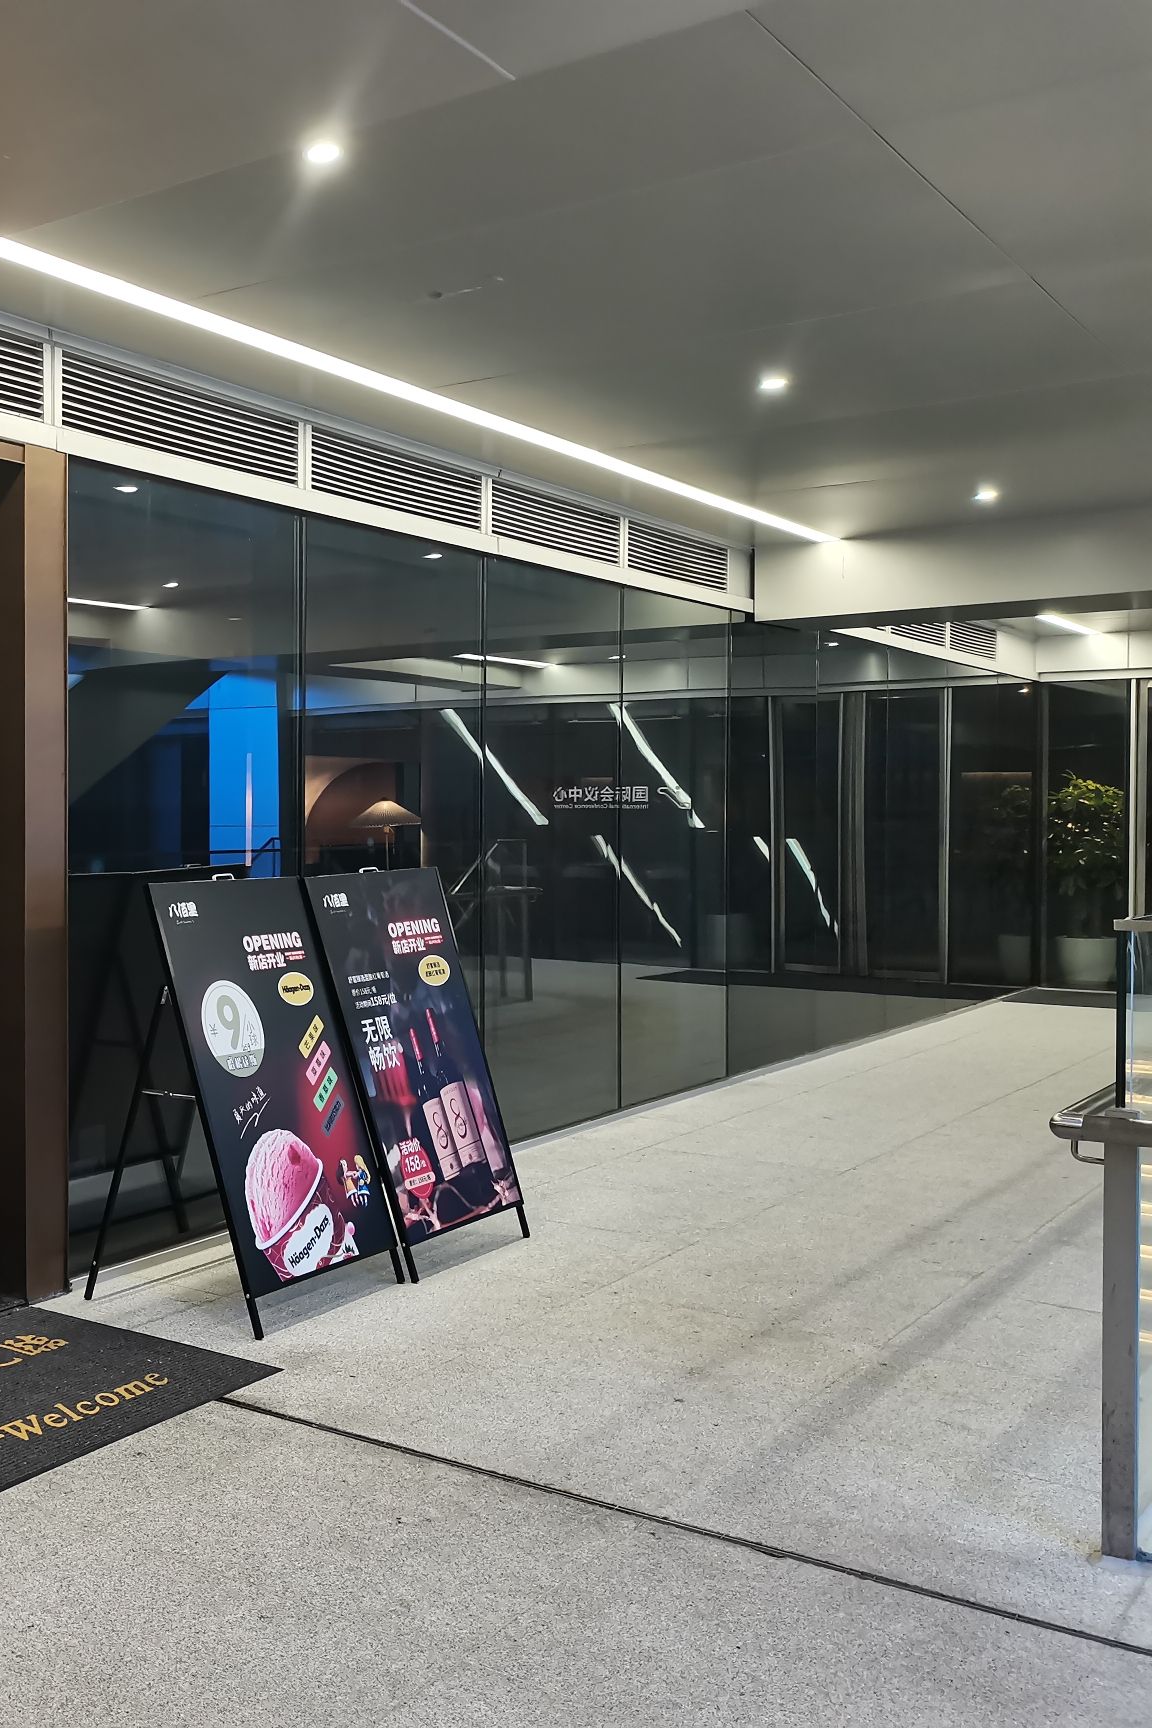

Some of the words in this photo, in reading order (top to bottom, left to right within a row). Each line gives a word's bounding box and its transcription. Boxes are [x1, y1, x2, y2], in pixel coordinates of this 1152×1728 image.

[387, 918, 441, 938] OPENING
[242, 931, 303, 952] OPENING
[391, 937, 426, 955] 新店开业
[247, 951, 287, 971] 新店开业
[361, 1016, 393, 1044] 无限
[369, 1042, 401, 1073] 畅饮
